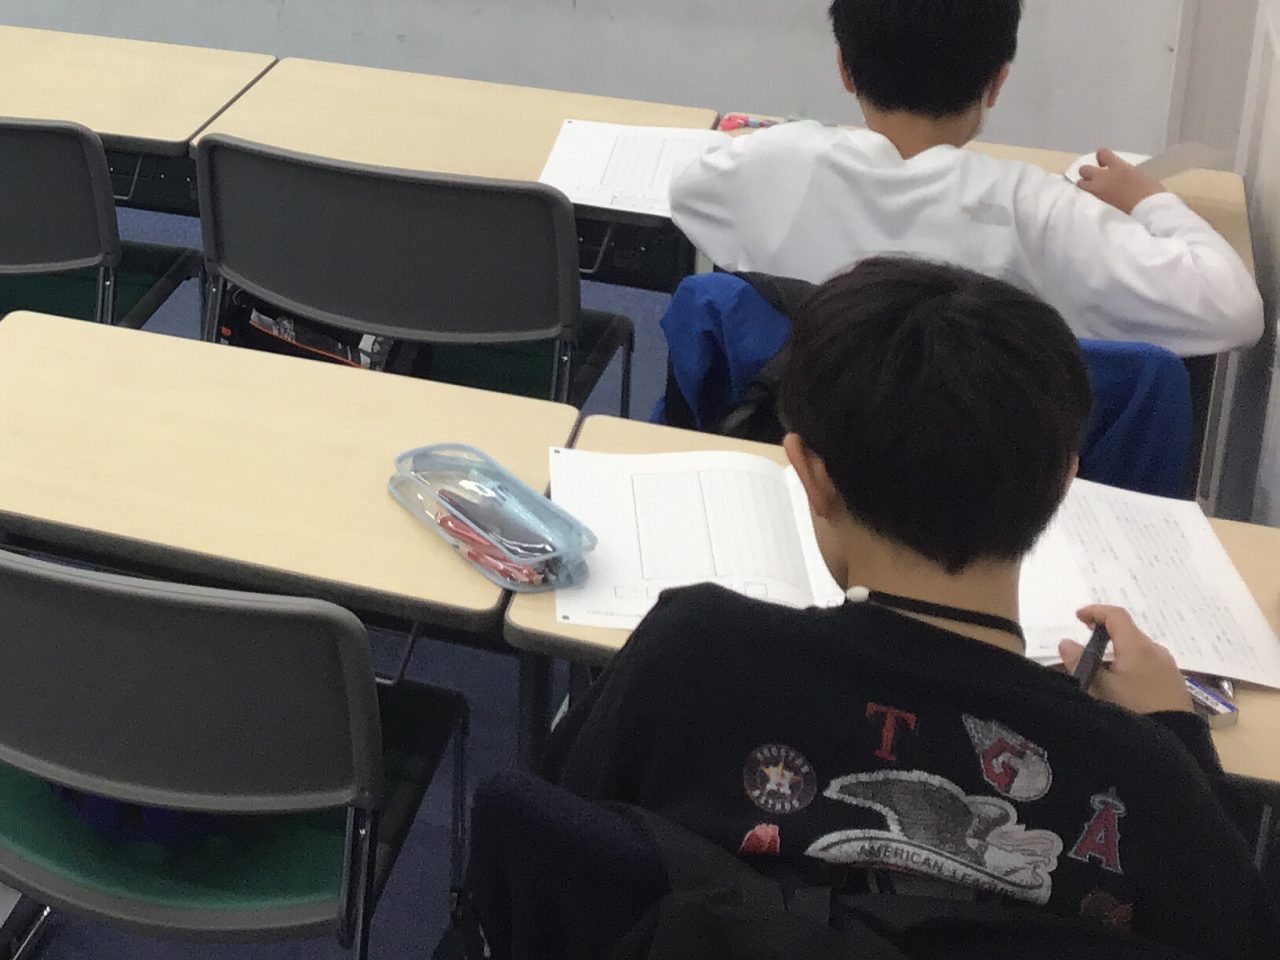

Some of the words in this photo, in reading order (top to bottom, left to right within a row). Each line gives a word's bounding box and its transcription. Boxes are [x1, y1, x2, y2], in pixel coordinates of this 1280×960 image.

[866, 702, 918, 761] T
[857, 843, 945, 874] AMERICAN
[1068, 797, 1125, 874] A
